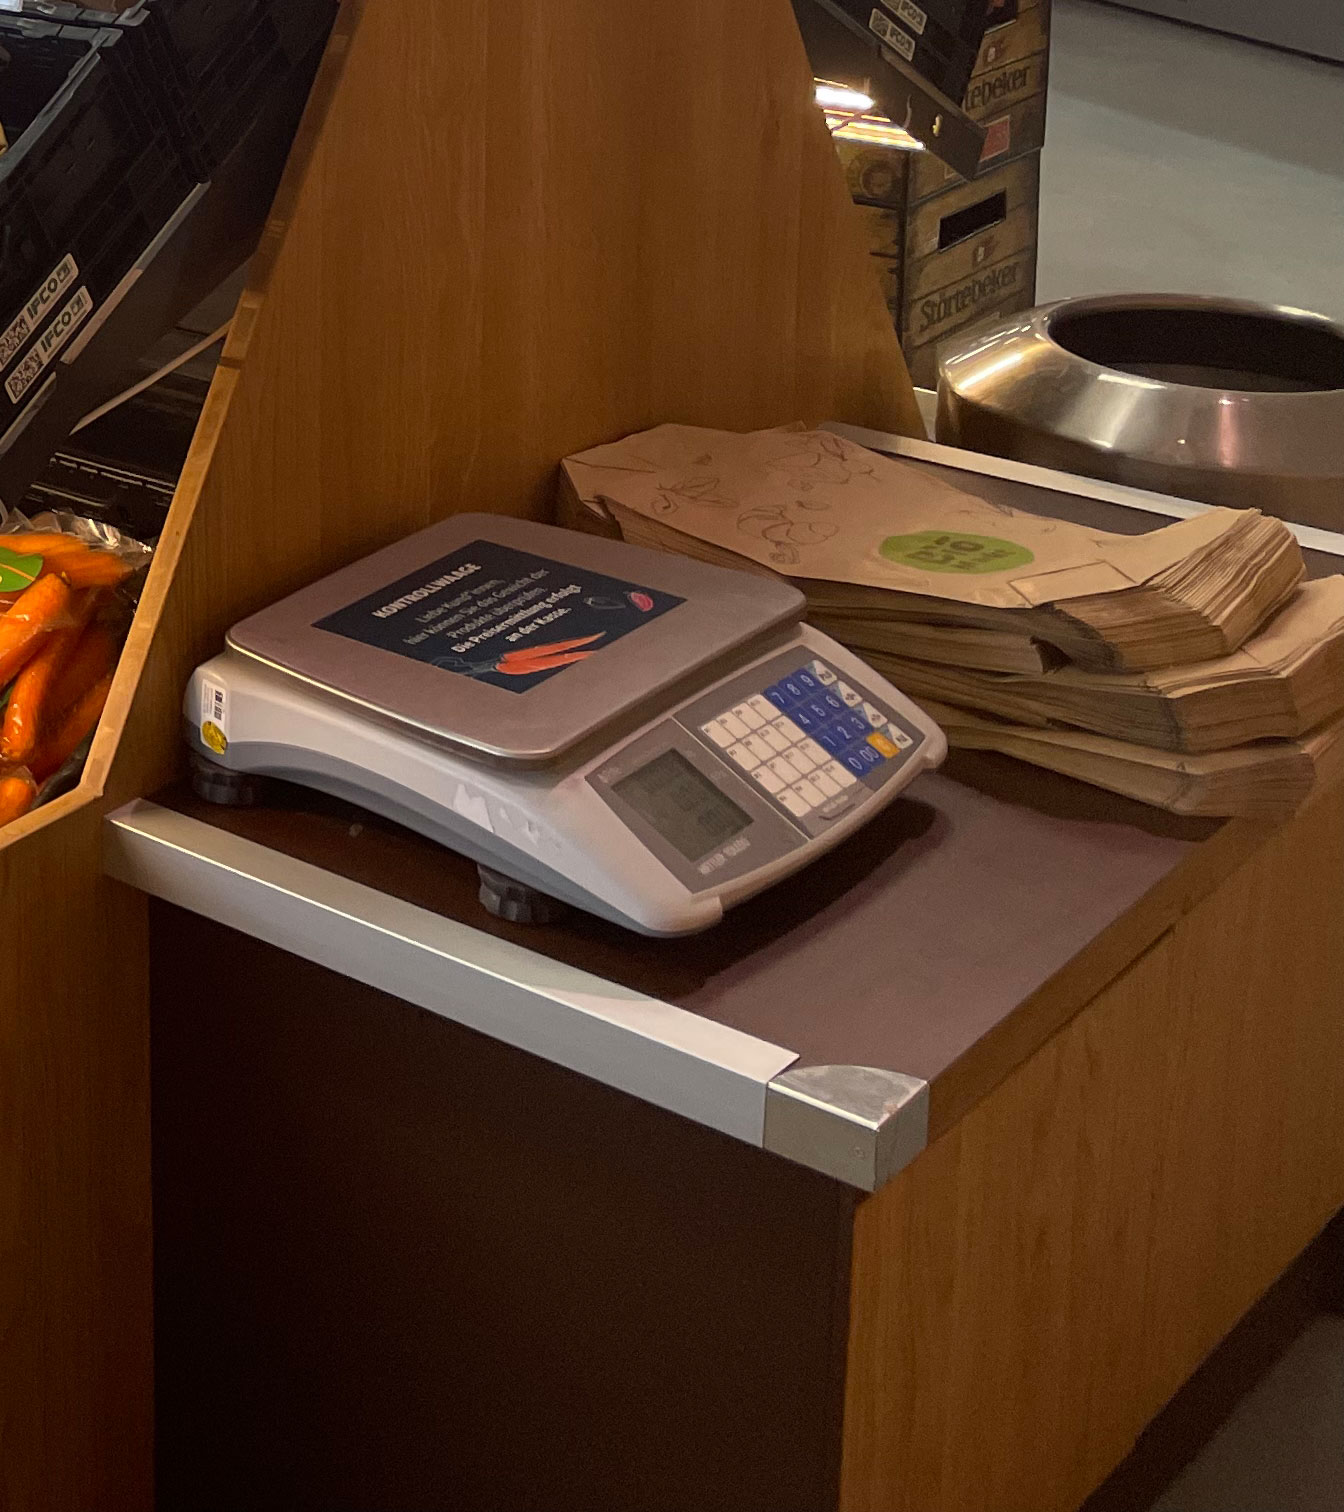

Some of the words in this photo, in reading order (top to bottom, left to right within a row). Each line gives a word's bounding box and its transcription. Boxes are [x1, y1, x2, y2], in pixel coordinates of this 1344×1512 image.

[26, 277, 58, 320] IFCO
[920, 261, 1021, 333] Störtebeker
[41, 311, 72, 352] IFCO
[372, 562, 482, 619] KONTROLLWAAGE
[423, 613, 464, 638] können
[446, 614, 493, 640] Produkte
[450, 638, 470, 653] Die
[468, 601, 553, 644] Preisermittlung
[545, 584, 582, 605] erfolgt
[505, 630, 522, 642] an
[518, 621, 539, 635] der
[536, 607, 572, 626] Kasse.
[771, 691, 786, 704] 7
[786, 683, 801, 696] 8
[800, 674, 815, 687] 9
[798, 713, 810, 725] 4
[811, 704, 826, 717] 5
[825, 695, 840, 708] 6
[822, 735, 837, 747] 1
[837, 726, 852, 740] 2
[851, 716, 865, 730] 3
[848, 756, 863, 770] 0
[859, 746, 880, 763] 00
